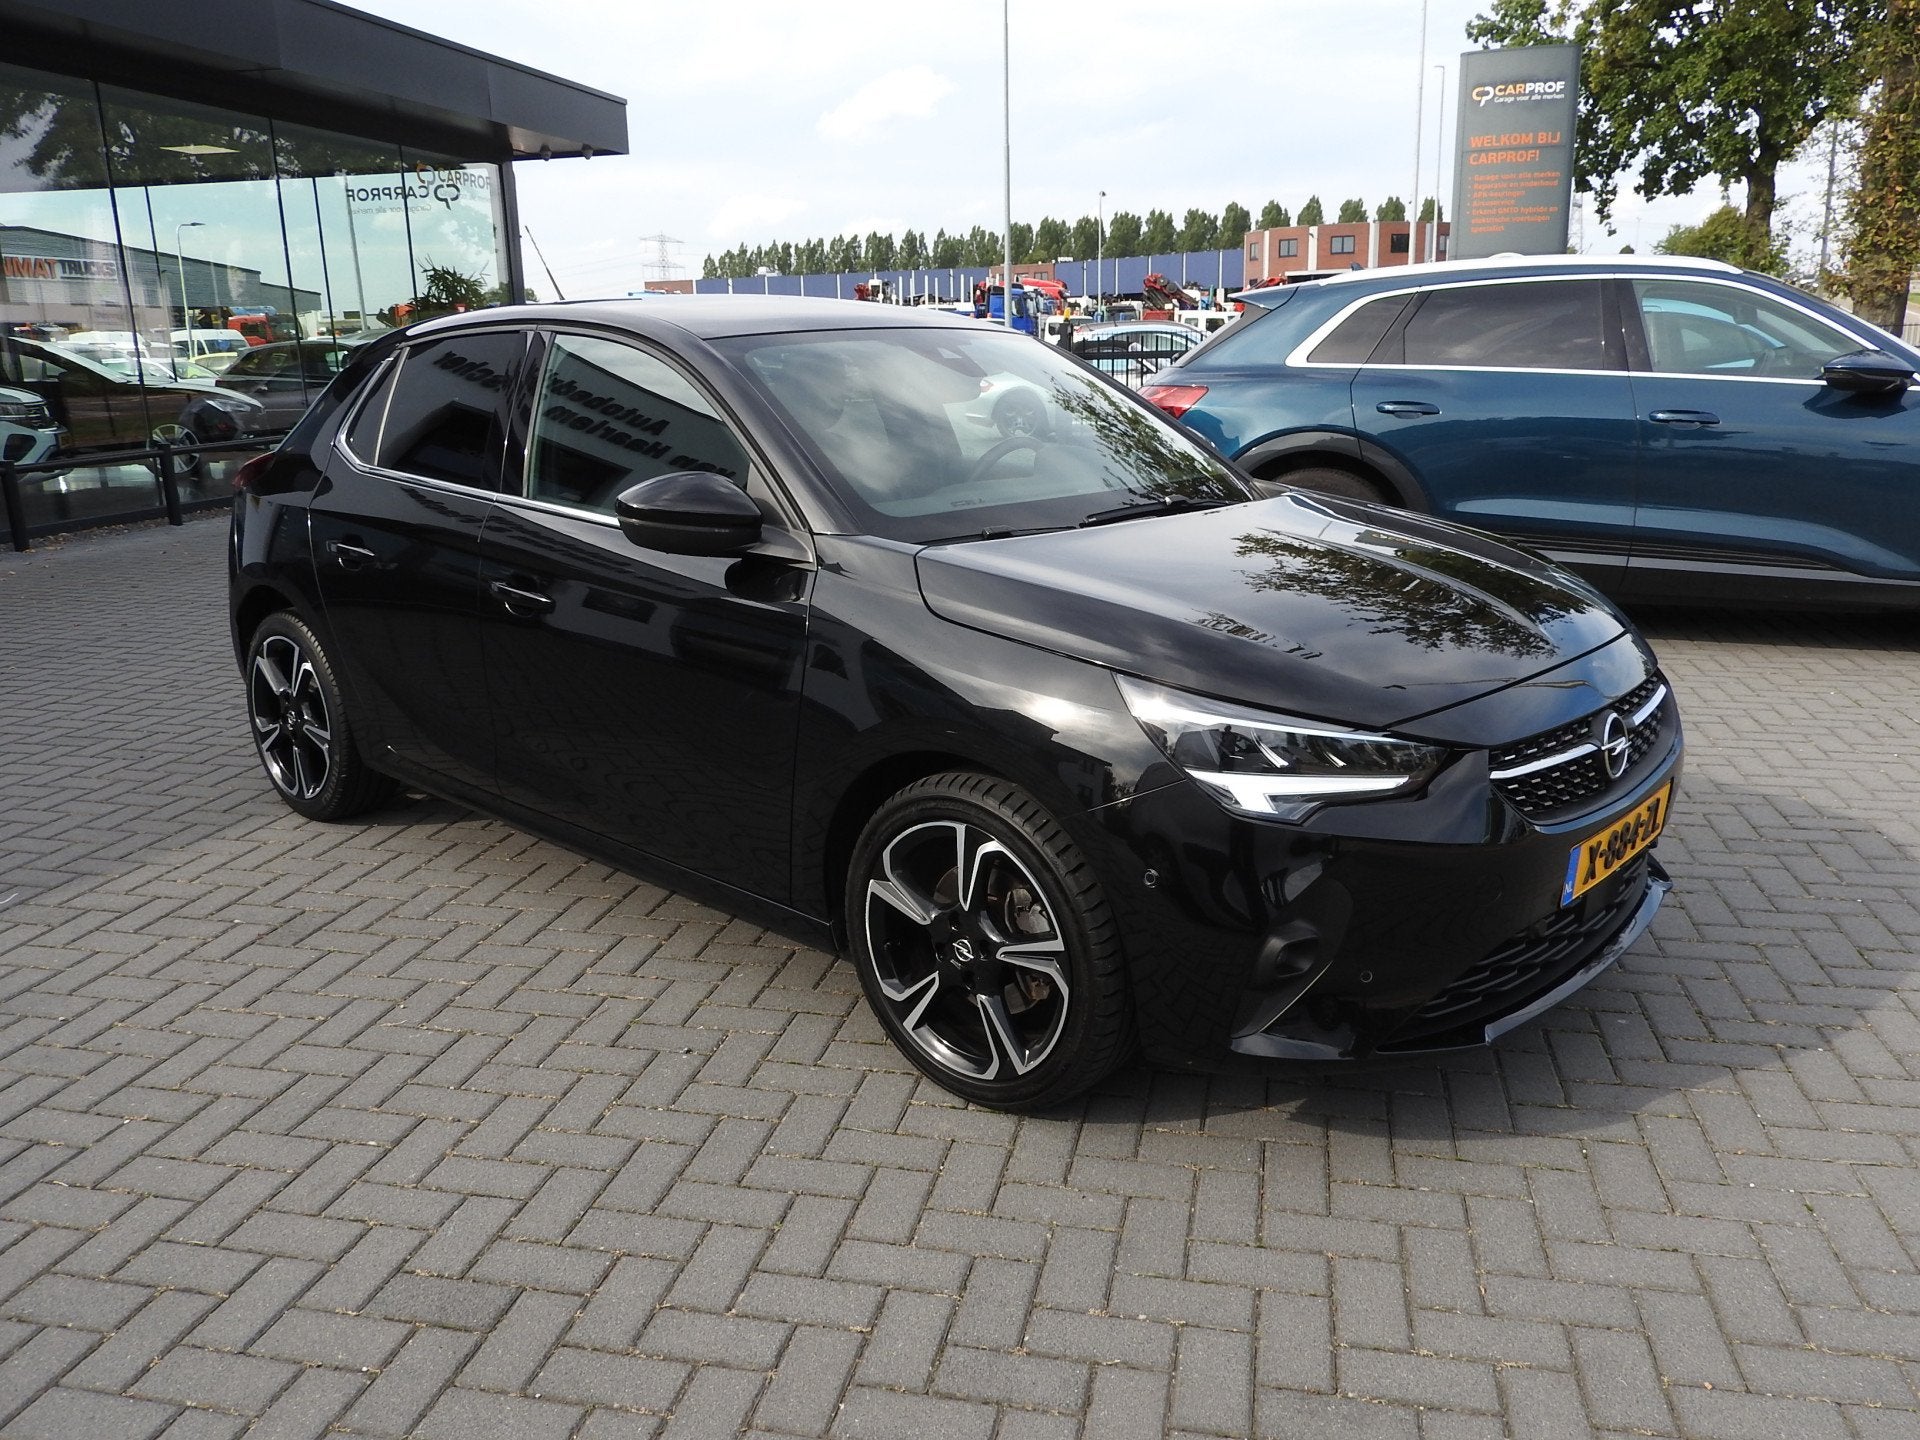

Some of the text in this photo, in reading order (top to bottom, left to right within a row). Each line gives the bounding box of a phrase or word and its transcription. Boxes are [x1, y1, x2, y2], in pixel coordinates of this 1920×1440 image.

[1495, 81, 1565, 96] CARPROF
[1470, 131, 1560, 148] WELKOM BIJ
[1469, 149, 1540, 166] CARPROF!
